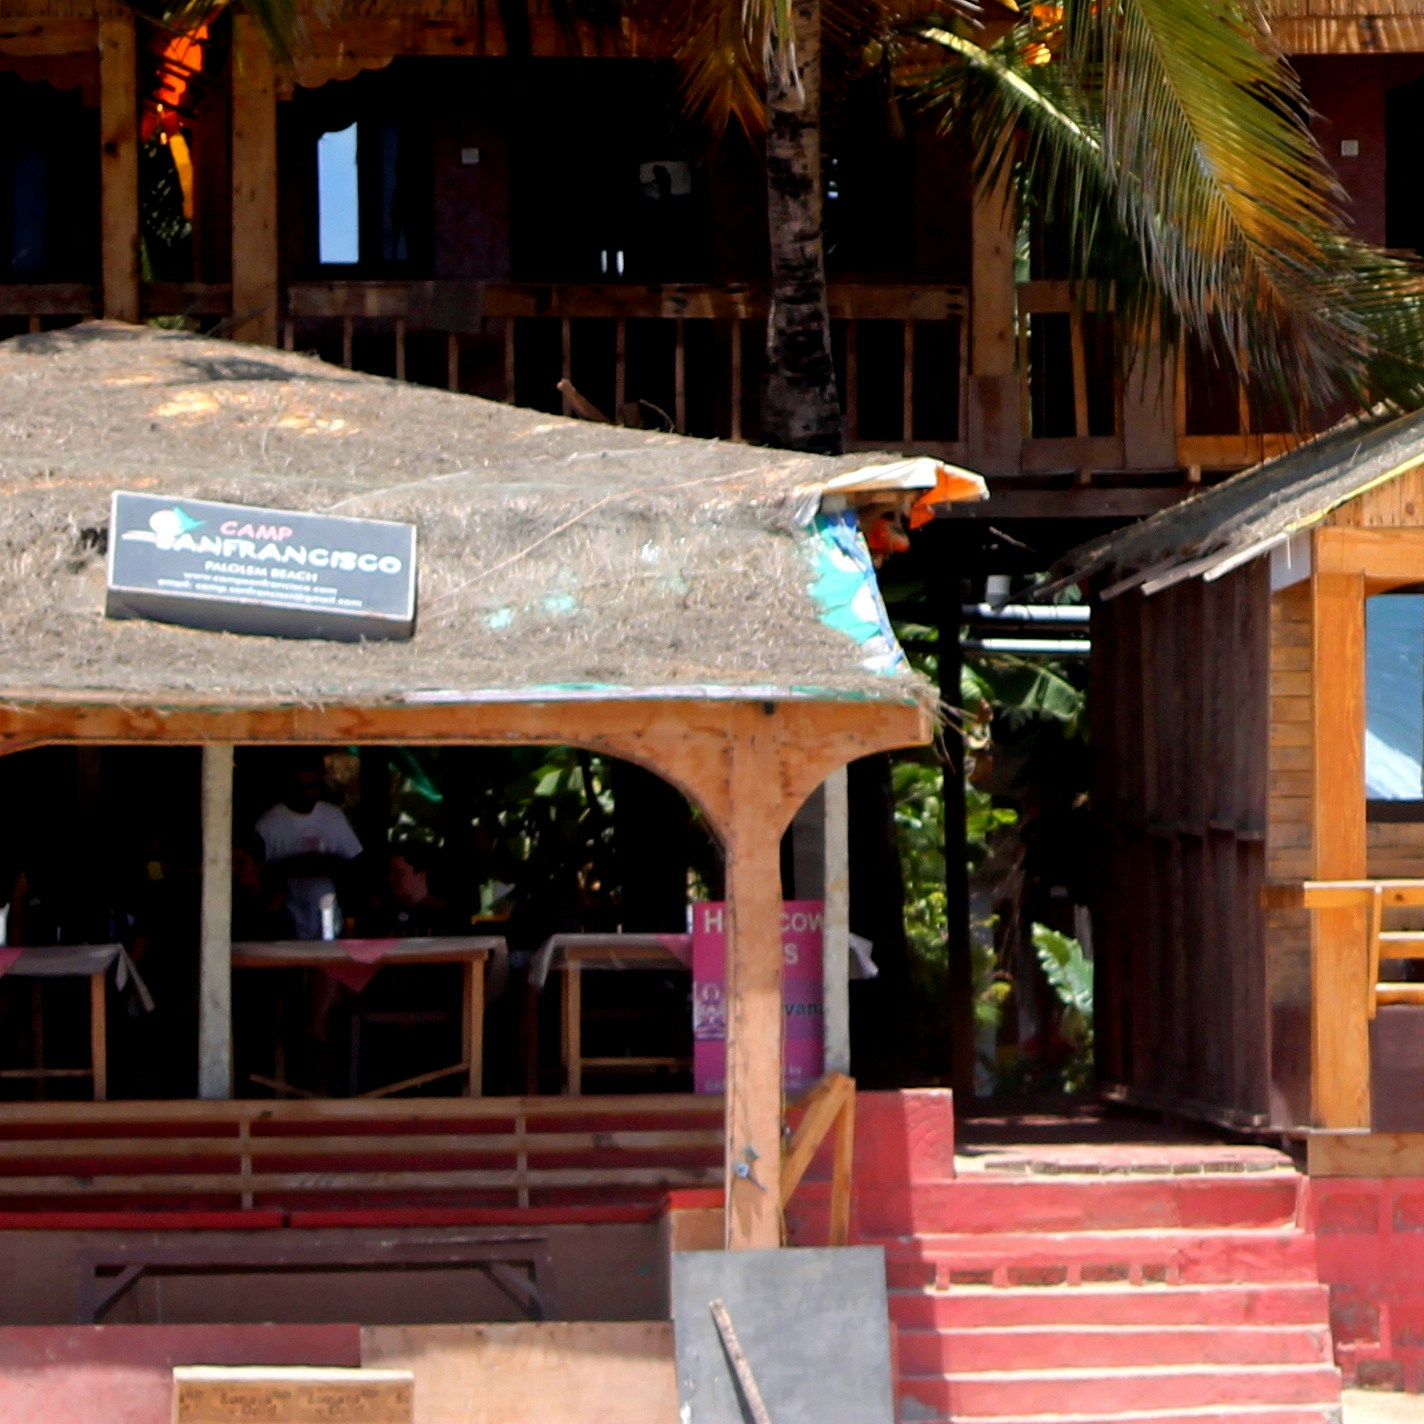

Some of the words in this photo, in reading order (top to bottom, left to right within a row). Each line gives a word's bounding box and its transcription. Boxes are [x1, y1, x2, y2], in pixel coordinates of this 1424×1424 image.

[219, 519, 293, 542] CAMP
[204, 559, 268, 577] PALOLEM
[270, 567, 319, 583] BEACH
